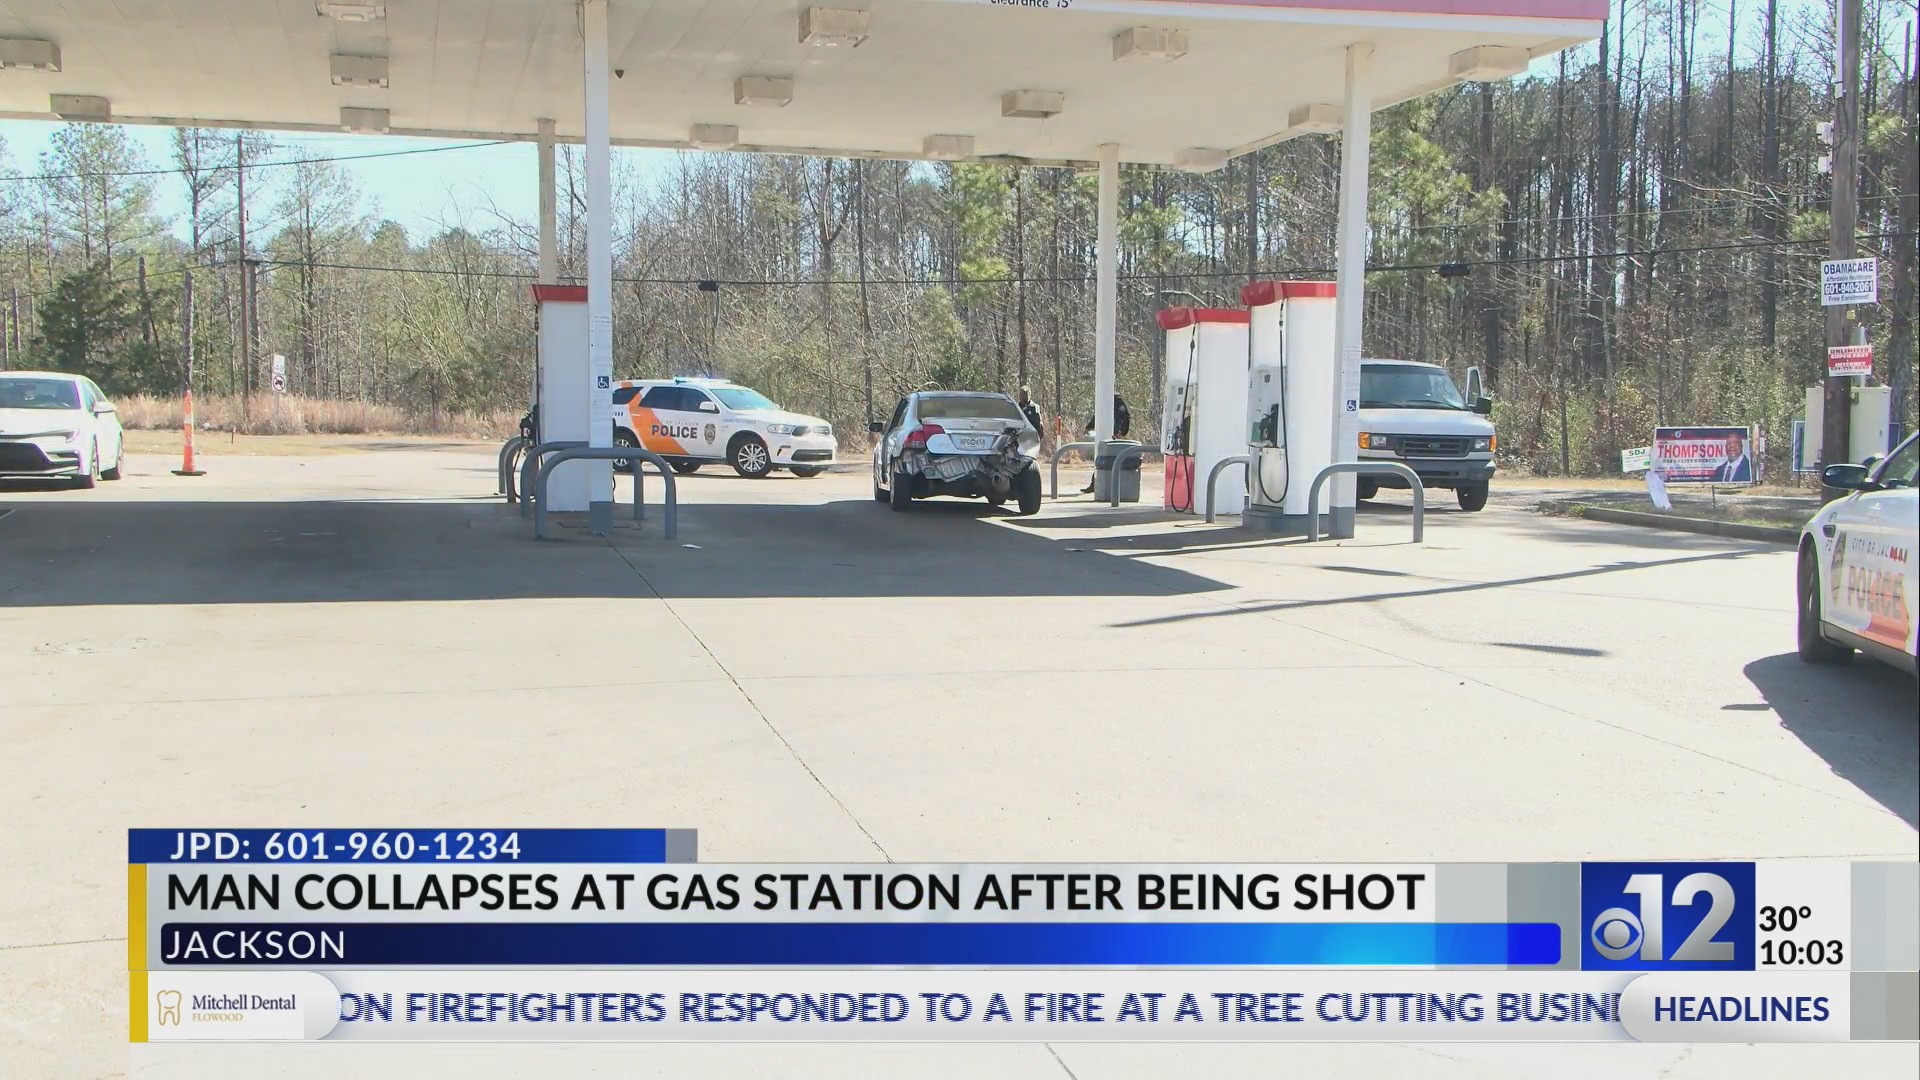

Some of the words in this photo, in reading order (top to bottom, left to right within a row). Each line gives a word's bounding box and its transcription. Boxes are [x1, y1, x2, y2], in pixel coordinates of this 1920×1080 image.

[1824, 262, 1874, 274] OBAMACARE
[652, 424, 698, 439] POLICE
[1657, 444, 1723, 458] THOMPSON
[1847, 565, 1904, 620] POLICE
